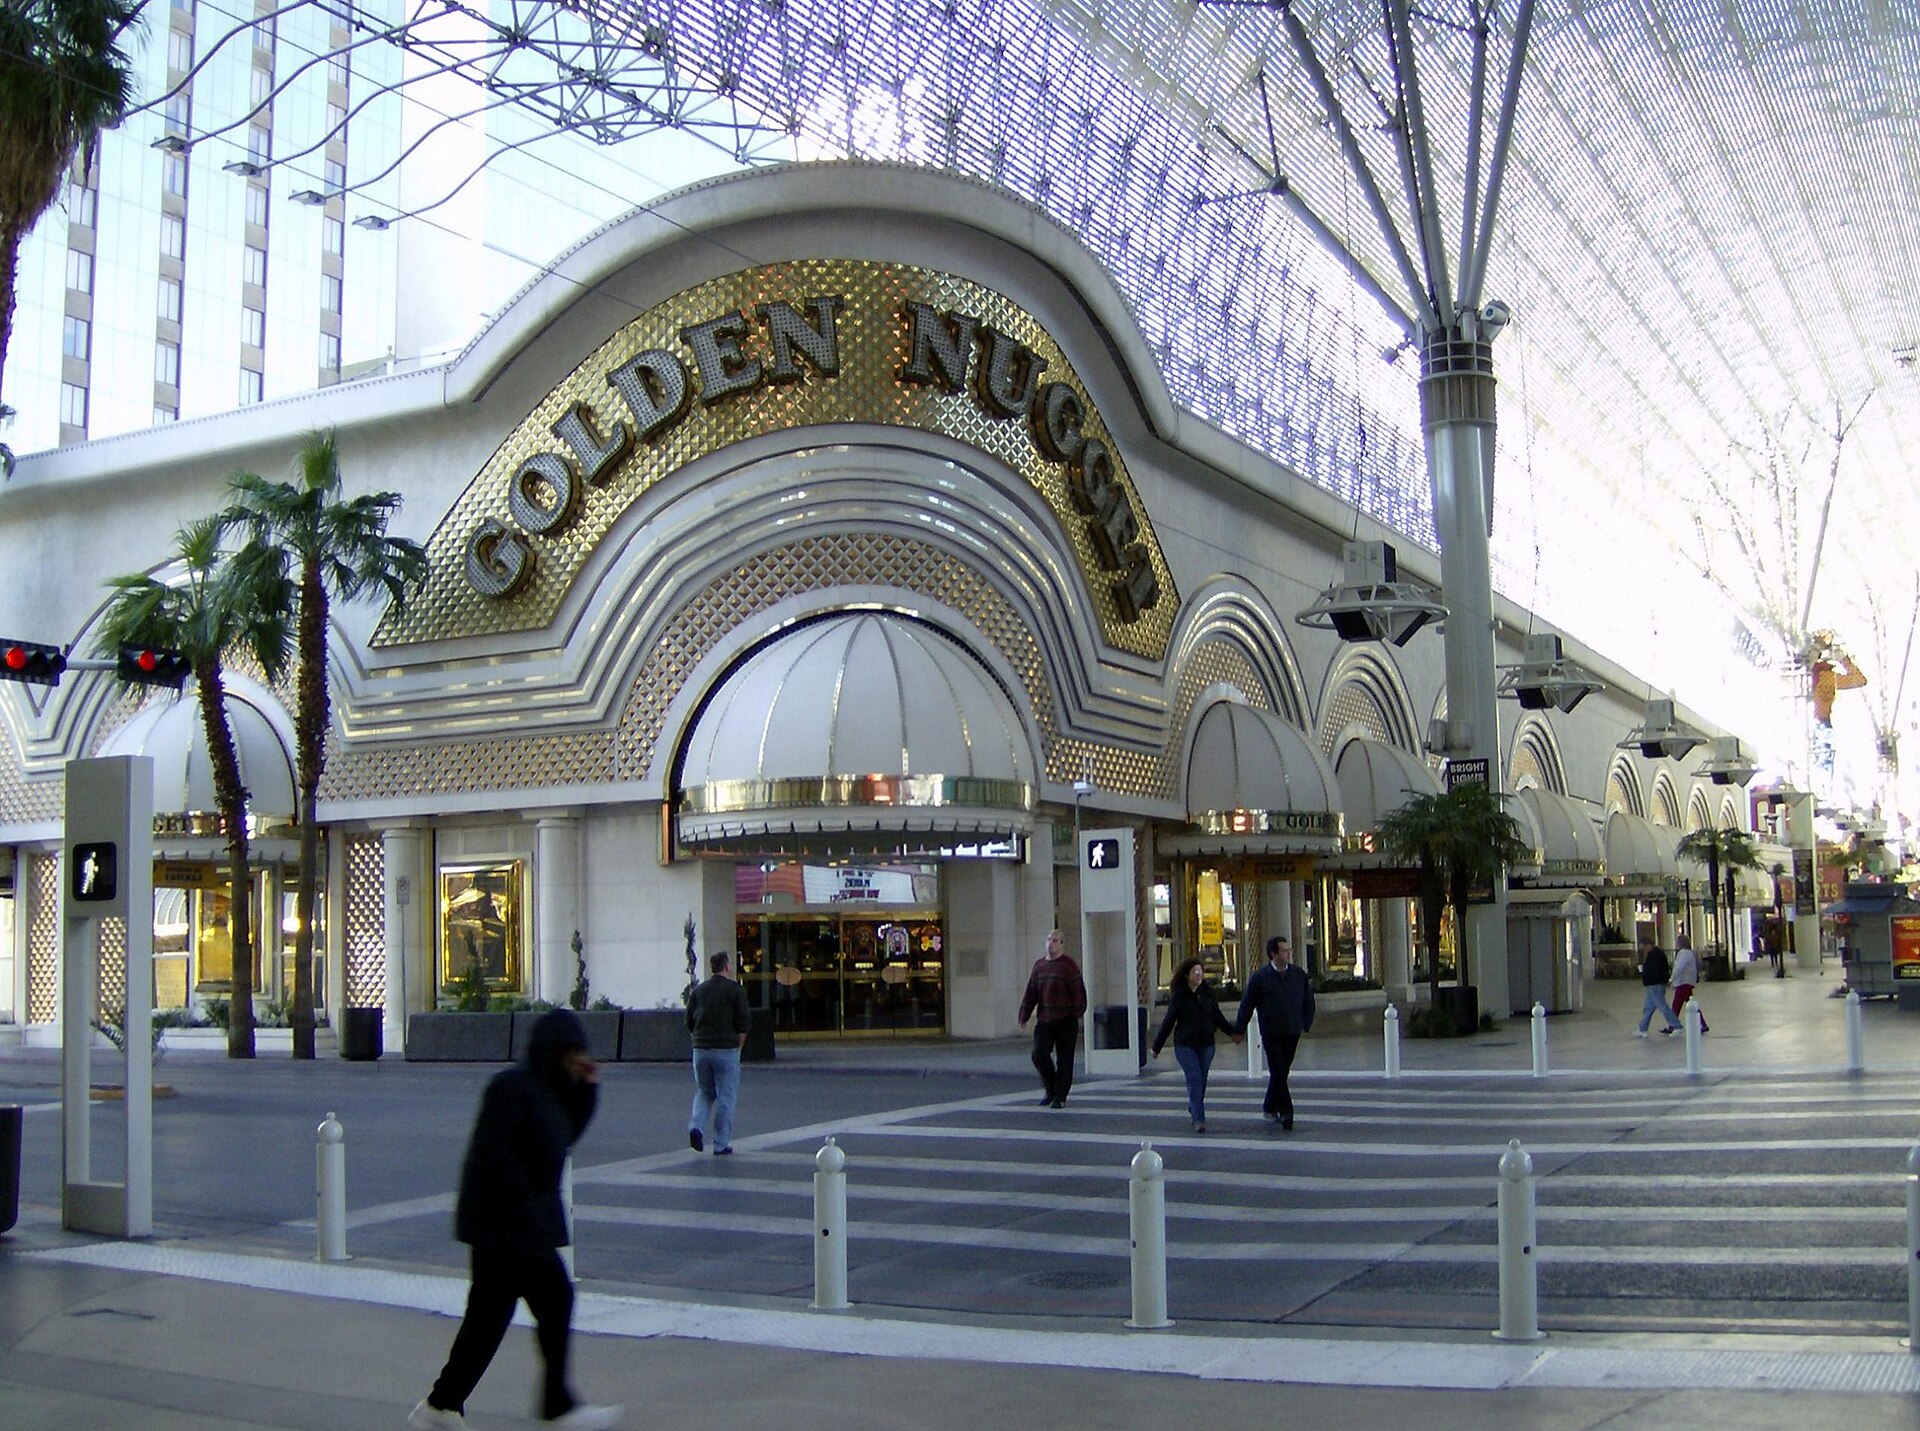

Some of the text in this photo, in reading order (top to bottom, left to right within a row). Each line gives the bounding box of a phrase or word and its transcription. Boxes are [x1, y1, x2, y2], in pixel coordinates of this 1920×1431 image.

[464, 293, 1159, 623] GOLDEN NUGGET
[1450, 762, 1485, 773] BRIGHT
[1452, 773, 1485, 784] LIGHTS
